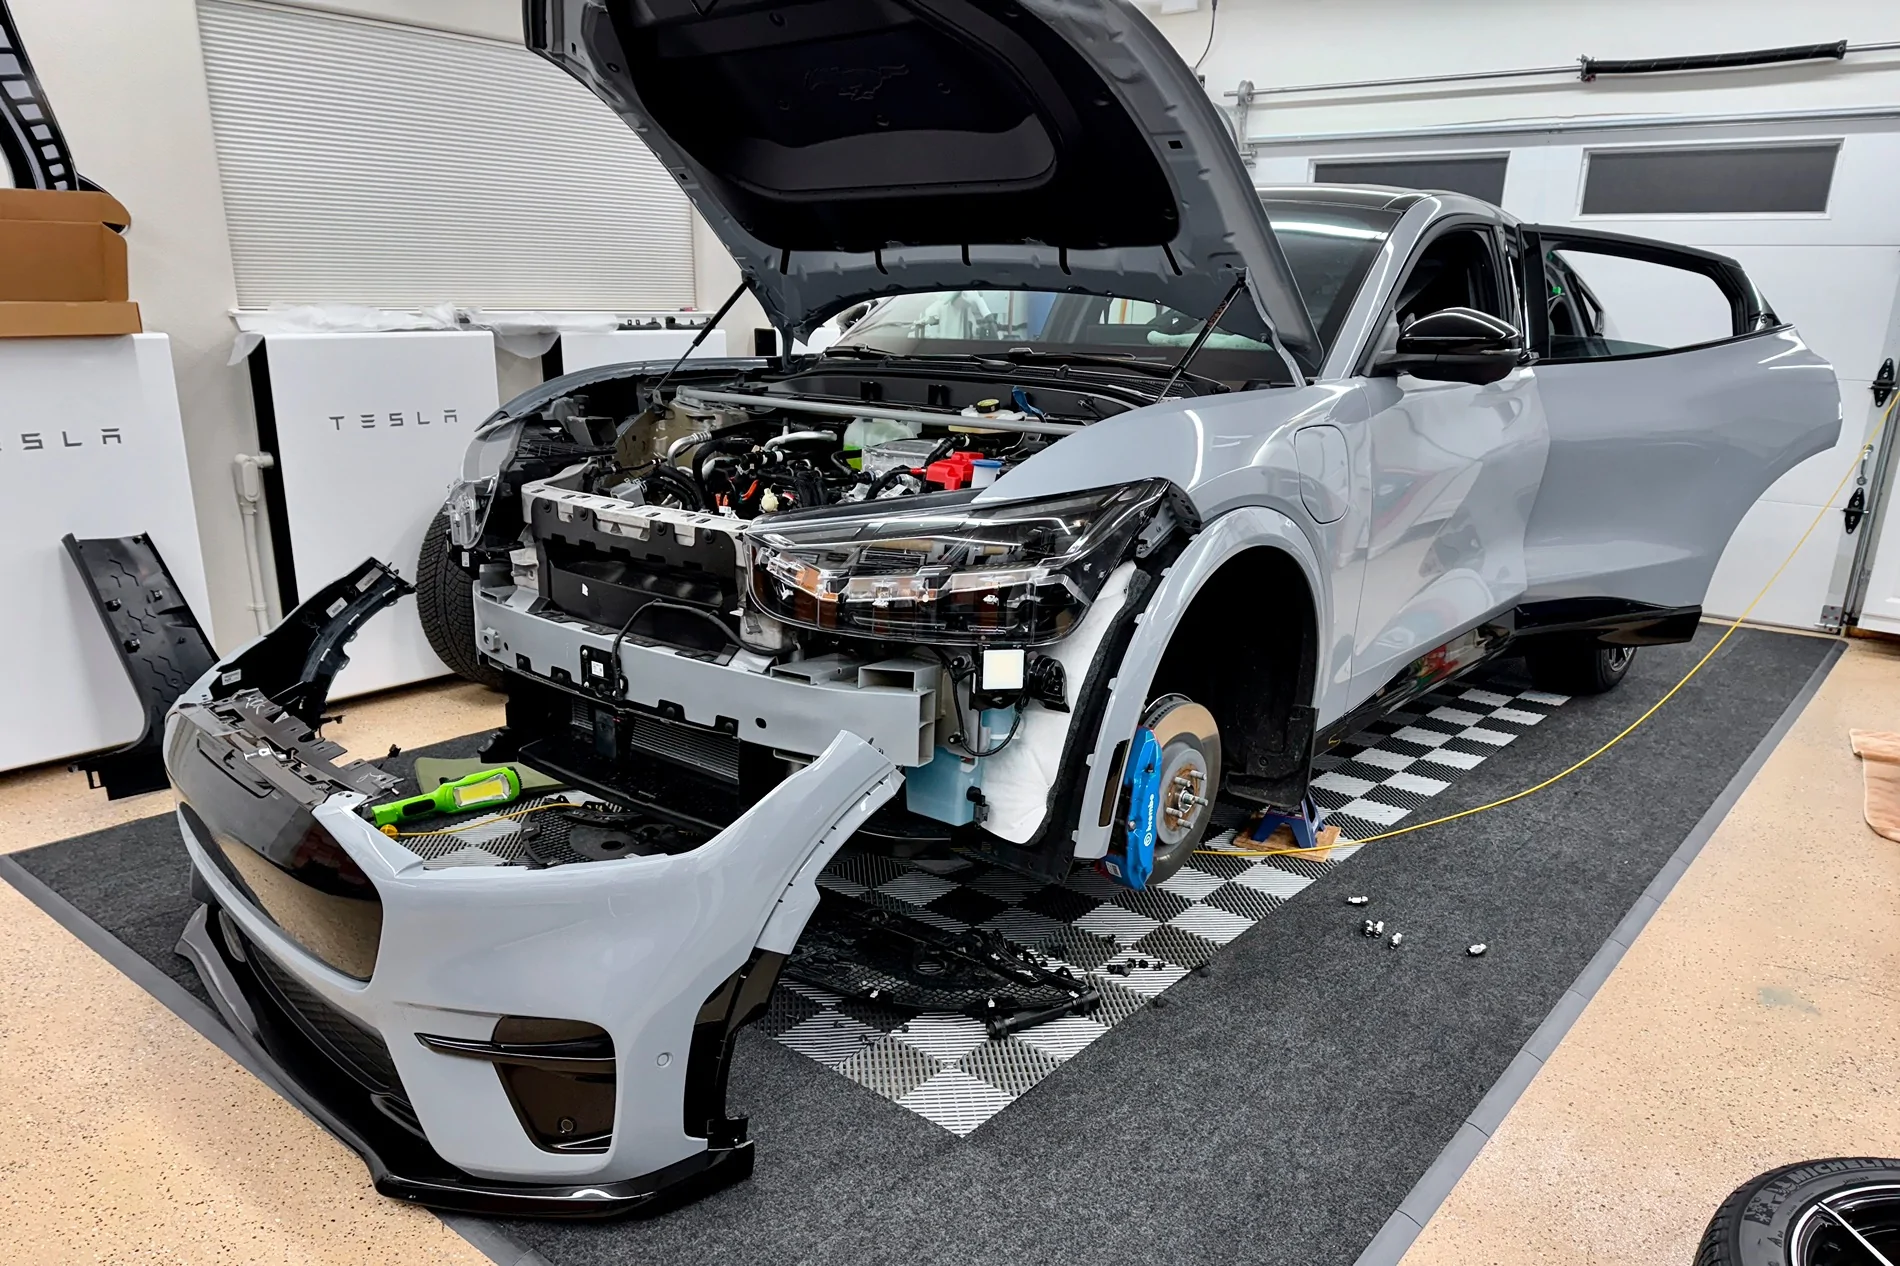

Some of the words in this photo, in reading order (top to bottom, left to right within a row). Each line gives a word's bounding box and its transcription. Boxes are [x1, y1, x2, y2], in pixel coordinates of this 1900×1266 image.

[328, 409, 458, 431] TESLA
[0, 428, 122, 451] SLA
[1146, 794, 1154, 832] brembo
[1789, 1160, 1900, 1181] MICHELIN
